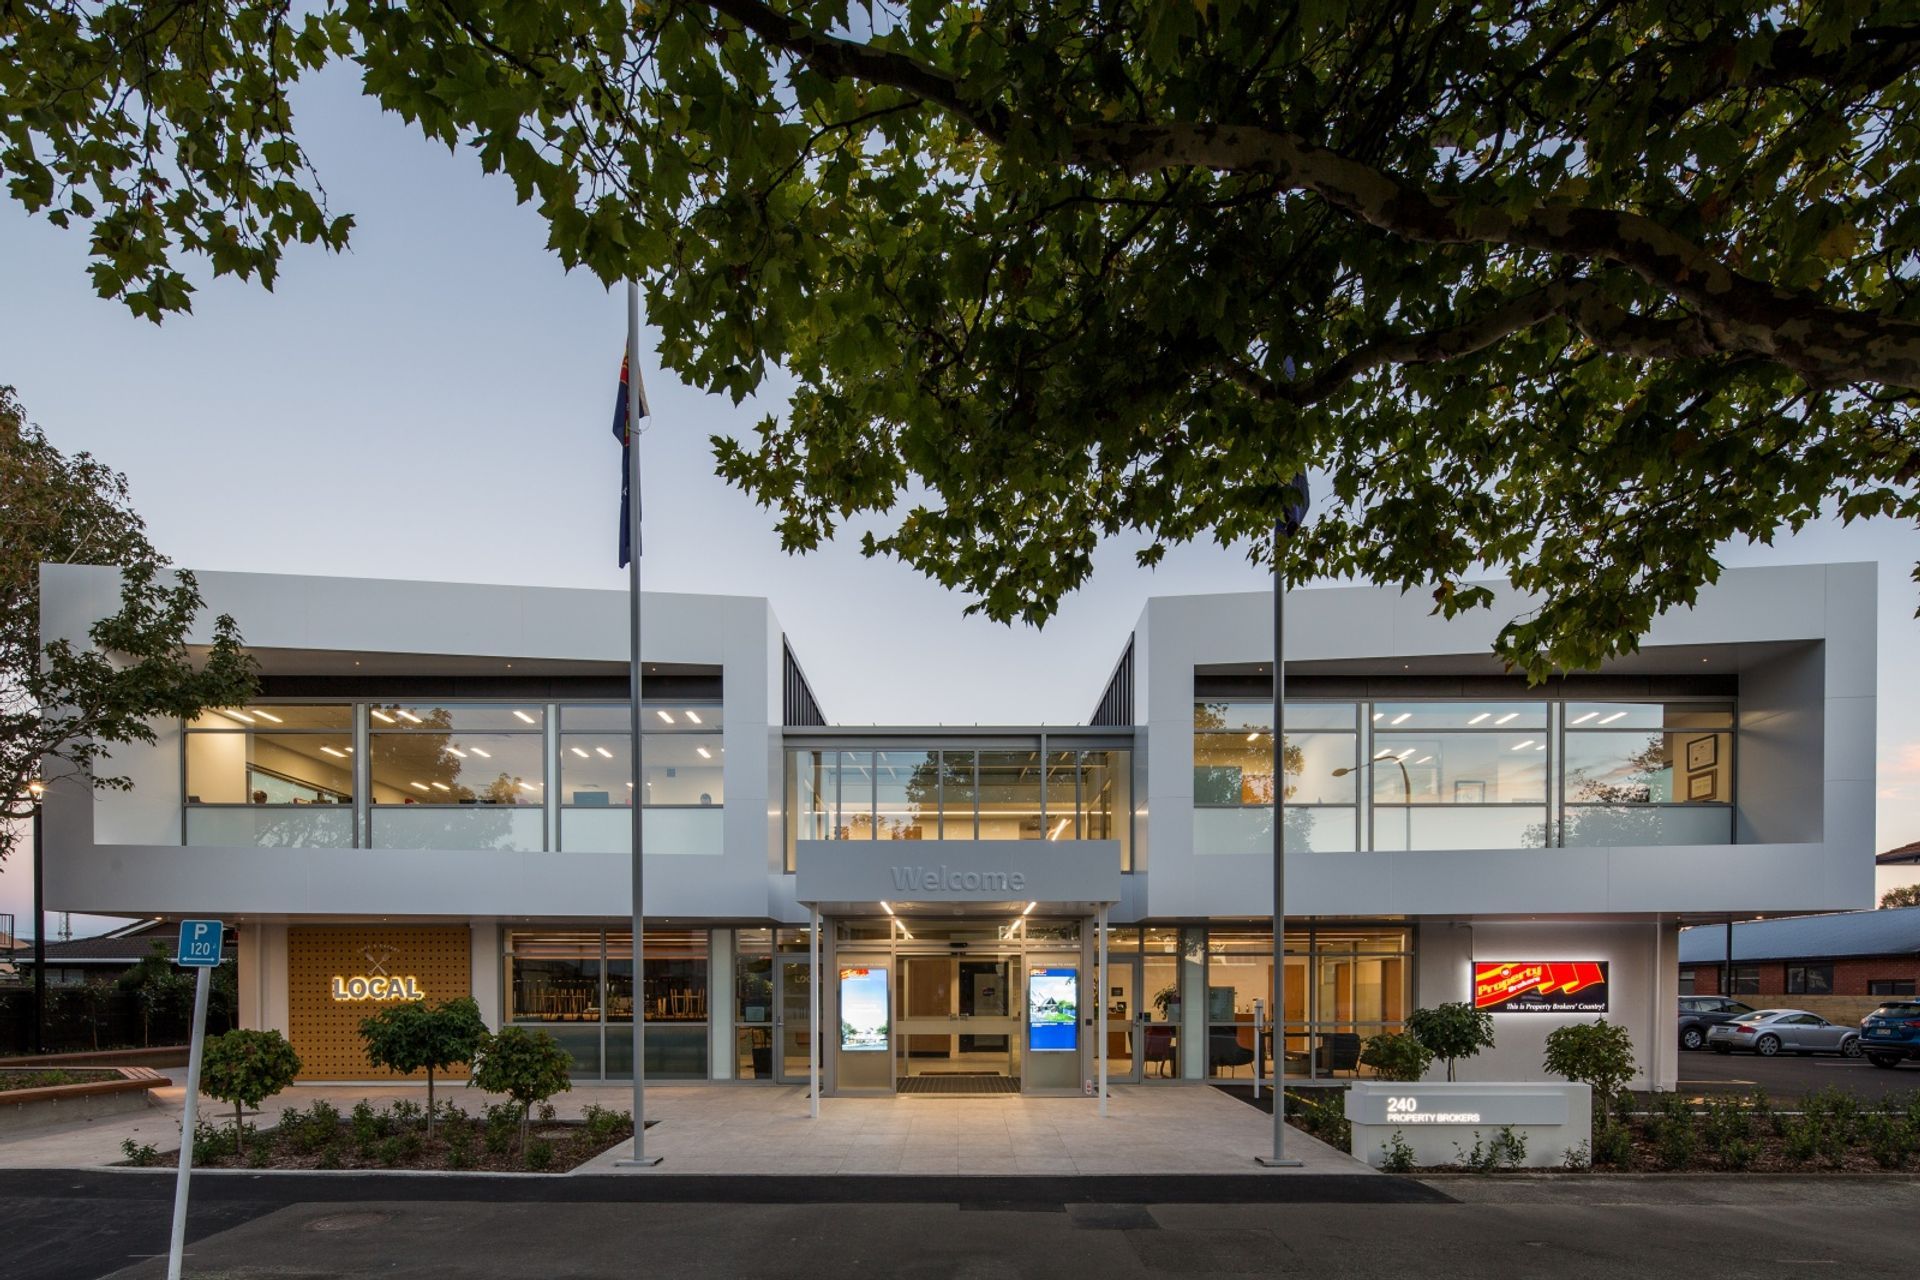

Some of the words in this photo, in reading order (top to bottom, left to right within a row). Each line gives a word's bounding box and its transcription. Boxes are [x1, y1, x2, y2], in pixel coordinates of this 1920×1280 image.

[890, 865, 1025, 892] Welcome
[194, 923, 208, 940] P
[190, 942, 210, 956] 120
[333, 977, 422, 999] LOCAL
[1478, 965, 1542, 996] Property
[1508, 976, 1541, 993] Brokers
[1525, 1003, 1552, 1011] Property
[1578, 1003, 1605, 1011] Country!
[1387, 1097, 1417, 1112] 240
[1387, 1113, 1436, 1122] PROPERTY
[1437, 1113, 1480, 1122] BROKERS
